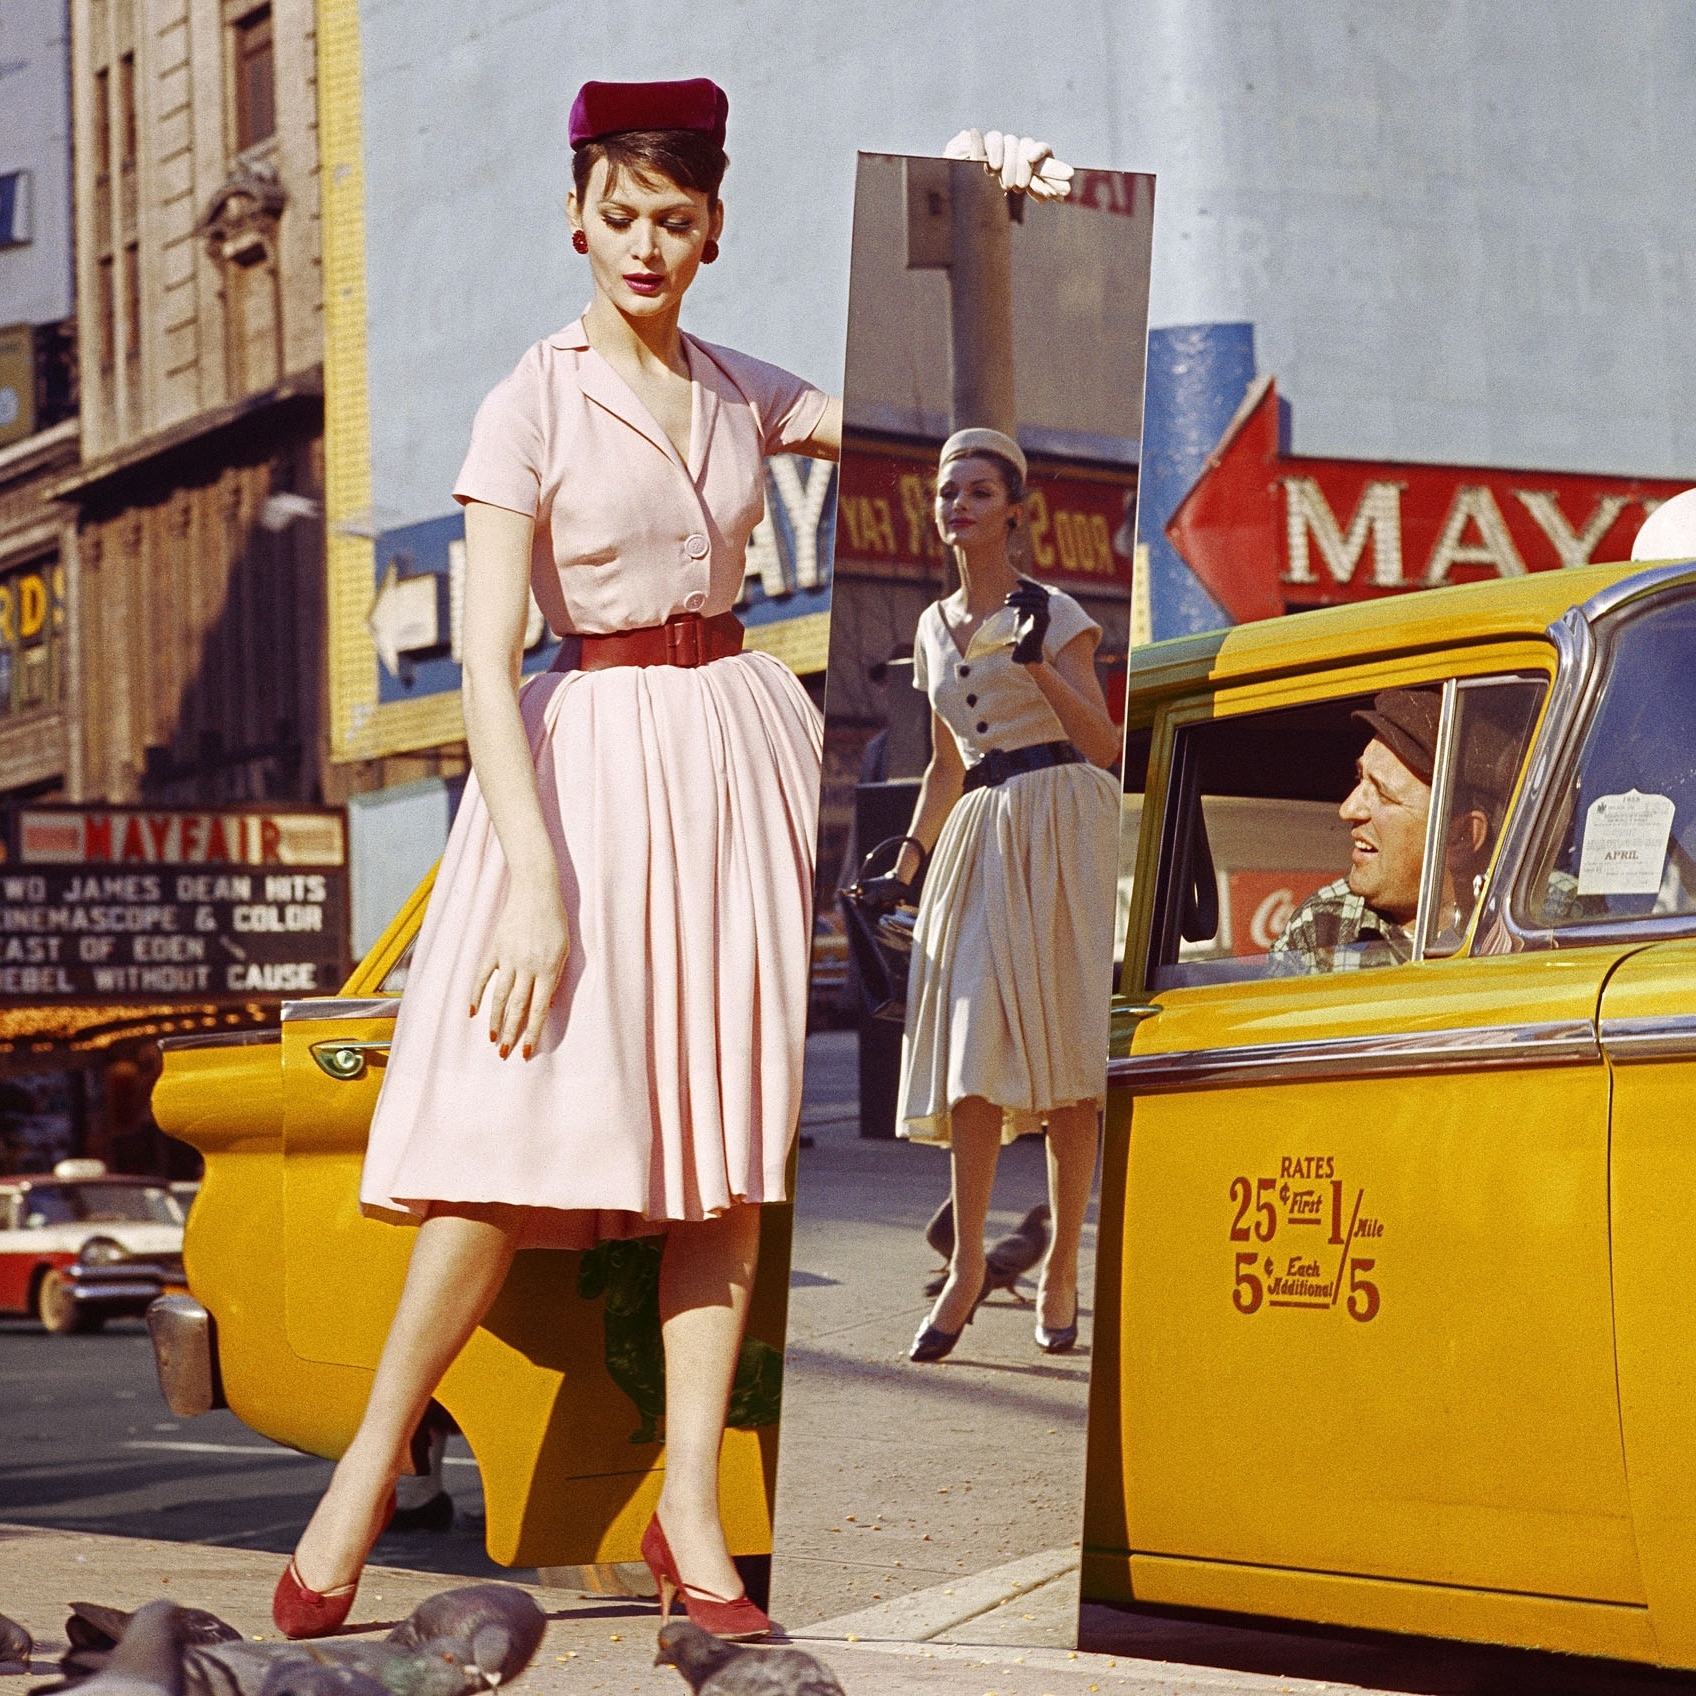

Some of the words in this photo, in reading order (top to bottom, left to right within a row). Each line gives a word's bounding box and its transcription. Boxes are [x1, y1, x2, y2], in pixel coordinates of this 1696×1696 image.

[1279, 475, 1666, 588] MAY
[84, 815, 281, 863] MAYFAIR
[1605, 850, 1639, 860] APRIL
[63, 875, 161, 901] JAMES
[176, 875, 251, 902] DEAN
[265, 874, 326, 902] HITS
[0, 905, 179, 931] INEMASCOPE
[195, 905, 217, 931] &
[233, 904, 322, 932] COLOR
[0, 936, 62, 962] AST
[79, 936, 116, 962] OF
[133, 935, 205, 962] EDEN
[0, 966, 75, 993] EBEL
[93, 964, 211, 992] WITHOUT
[227, 963, 317, 991] CAUSE
[1280, 1156, 1334, 1179] RATES
[1289, 1190, 1323, 1215] First
[1354, 1218, 1385, 1238] Mile
[1286, 1256, 1321, 1278] Each
[1267, 1277, 1335, 1299] Additional
